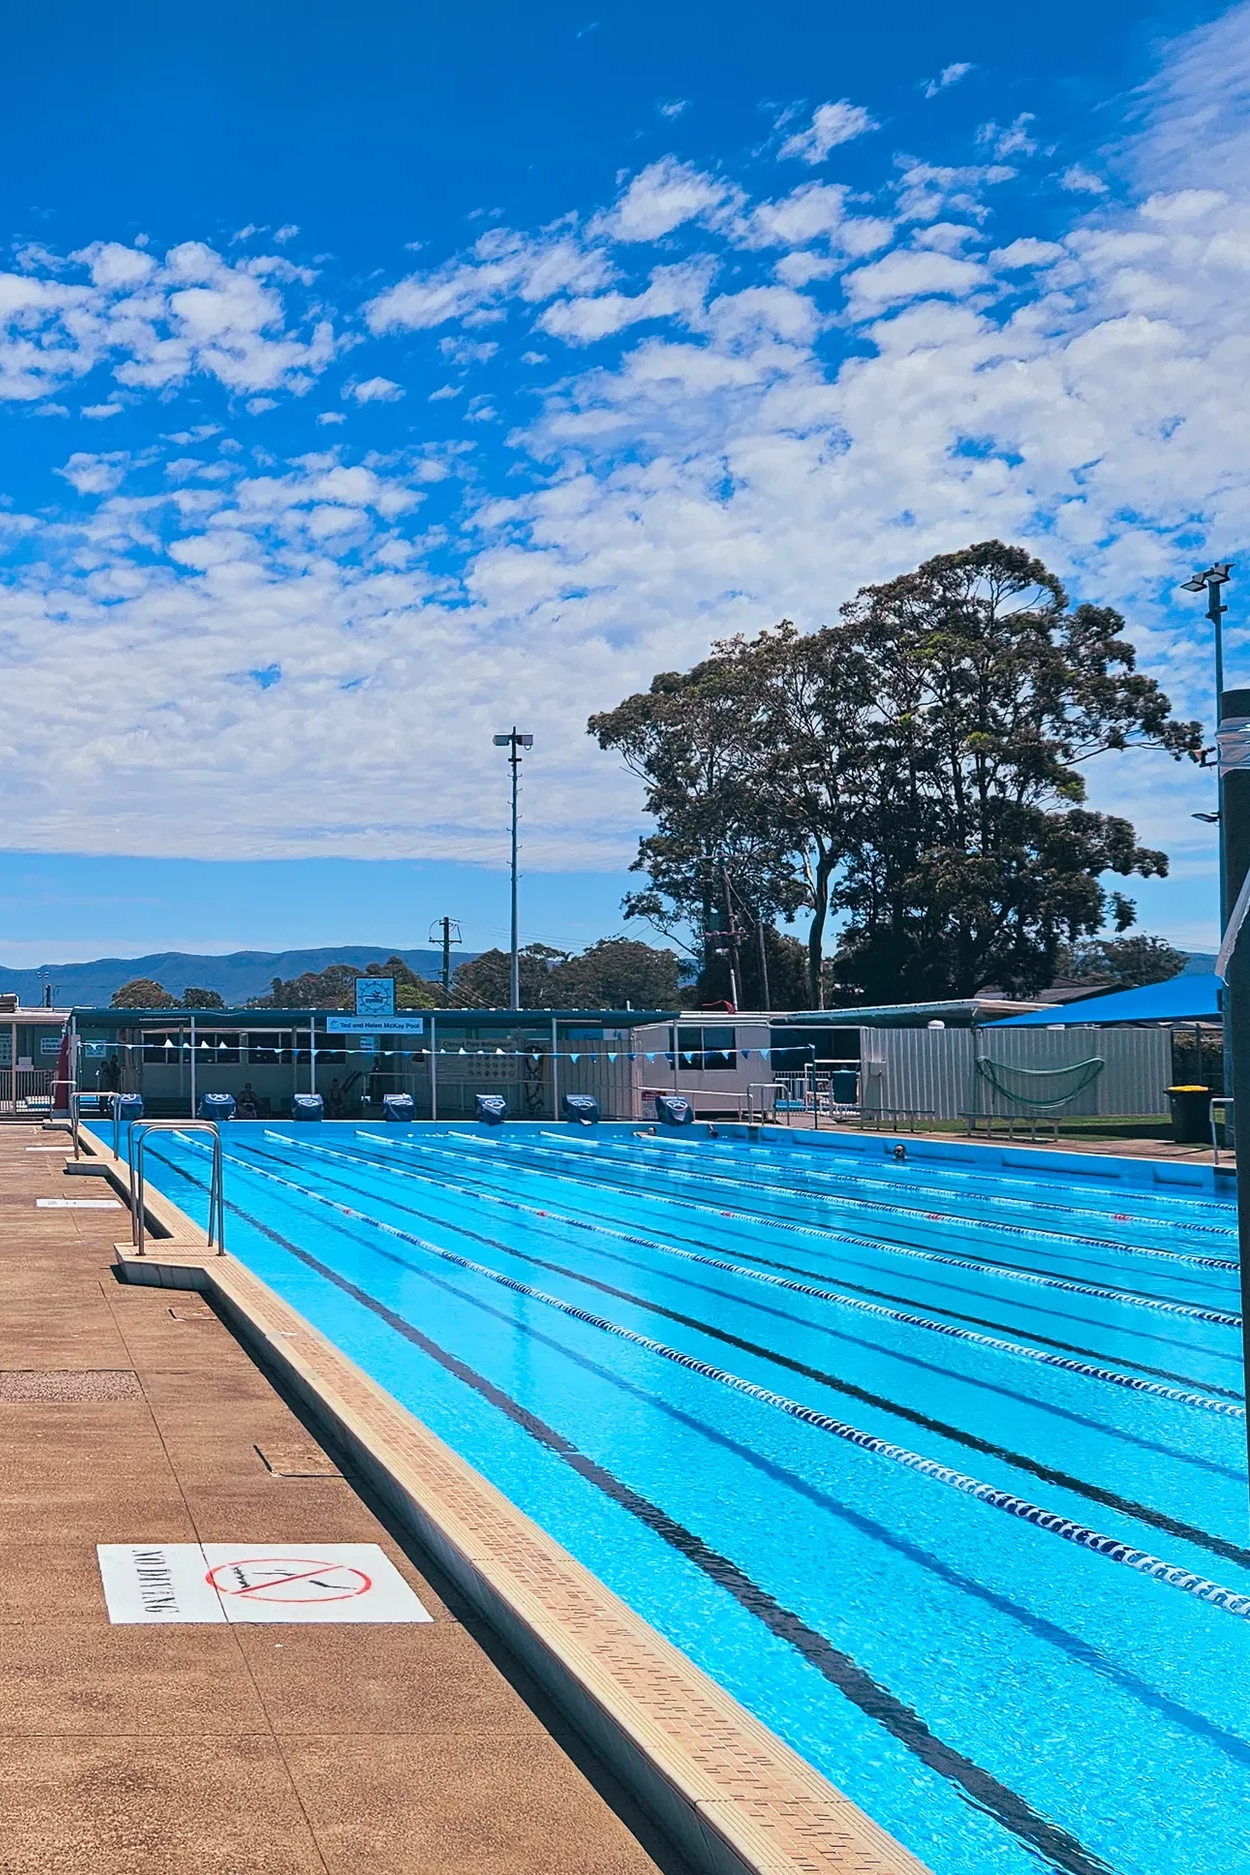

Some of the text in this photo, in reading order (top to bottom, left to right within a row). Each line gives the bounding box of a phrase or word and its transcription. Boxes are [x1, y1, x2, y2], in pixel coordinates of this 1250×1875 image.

[383, 1022, 405, 1030] McKay
[132, 1550, 179, 1613] NO DIVING
